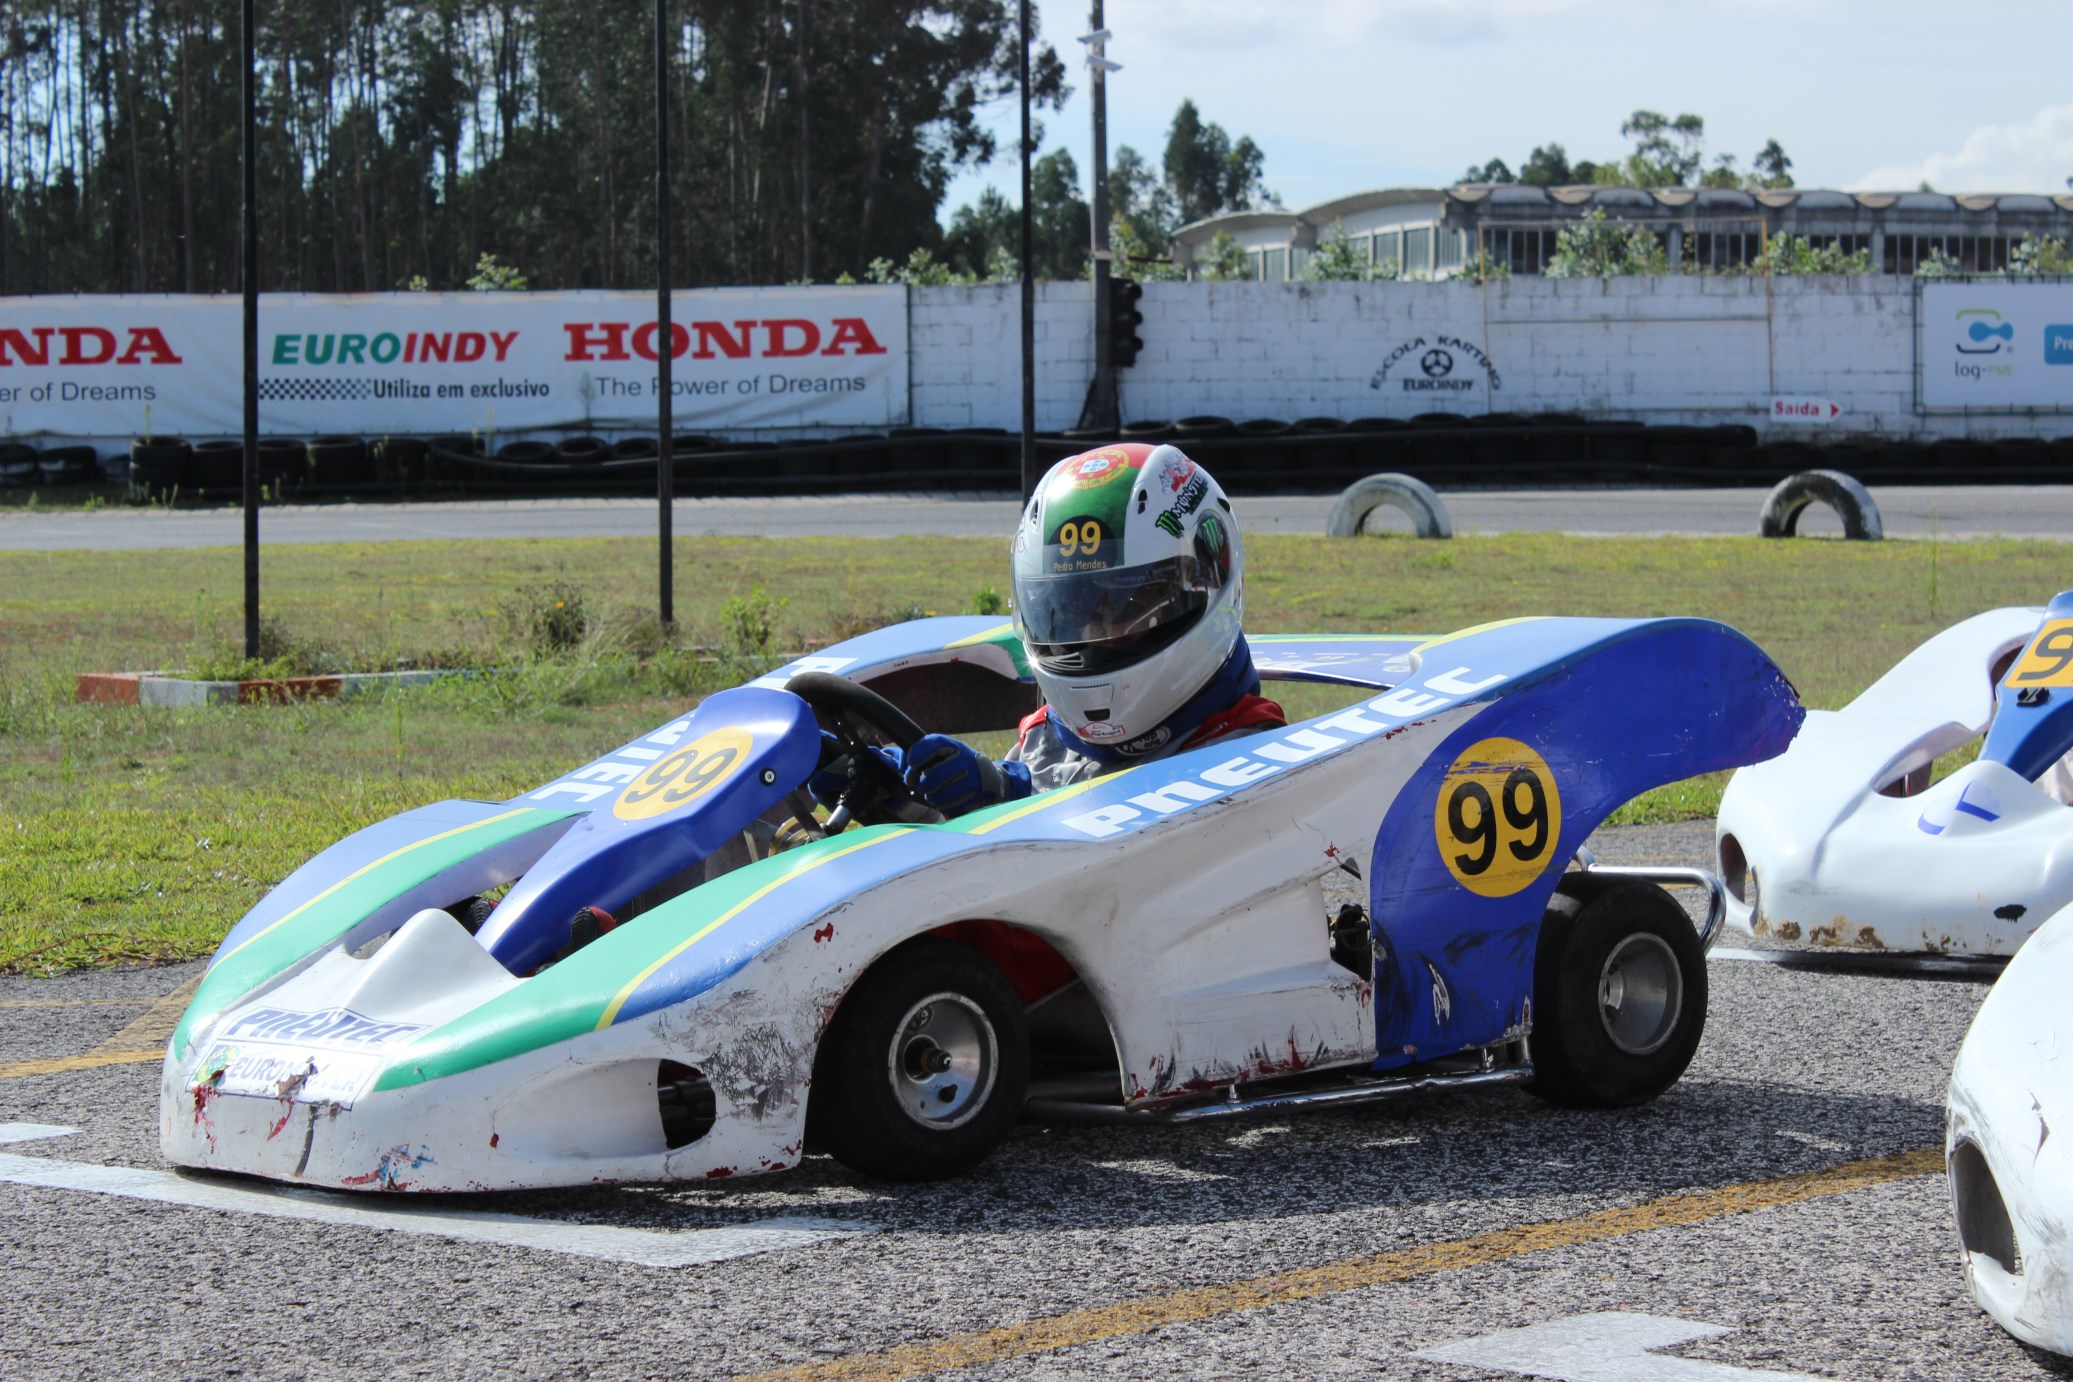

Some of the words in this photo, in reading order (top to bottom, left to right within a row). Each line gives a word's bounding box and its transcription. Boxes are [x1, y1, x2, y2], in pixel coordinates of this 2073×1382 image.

[271, 331, 519, 365] EUROINDY
[563, 318, 887, 362] HONDA
[30, 382, 53, 402] of
[62, 382, 156, 401] Dreams
[374, 379, 430, 398] Utiliza
[437, 384, 463, 398] em
[471, 377, 550, 398] exclusivo
[596, 377, 642, 396] The
[737, 374, 761, 395] of
[769, 374, 866, 395] Dreams
[1402, 378, 1474, 391] EUROINDY
[1060, 520, 1101, 557] 99
[1053, 561, 1074, 572] Pedro
[1076, 559, 1107, 570] Mendes
[623, 747, 738, 804] 99
[1447, 768, 1549, 876] 99
